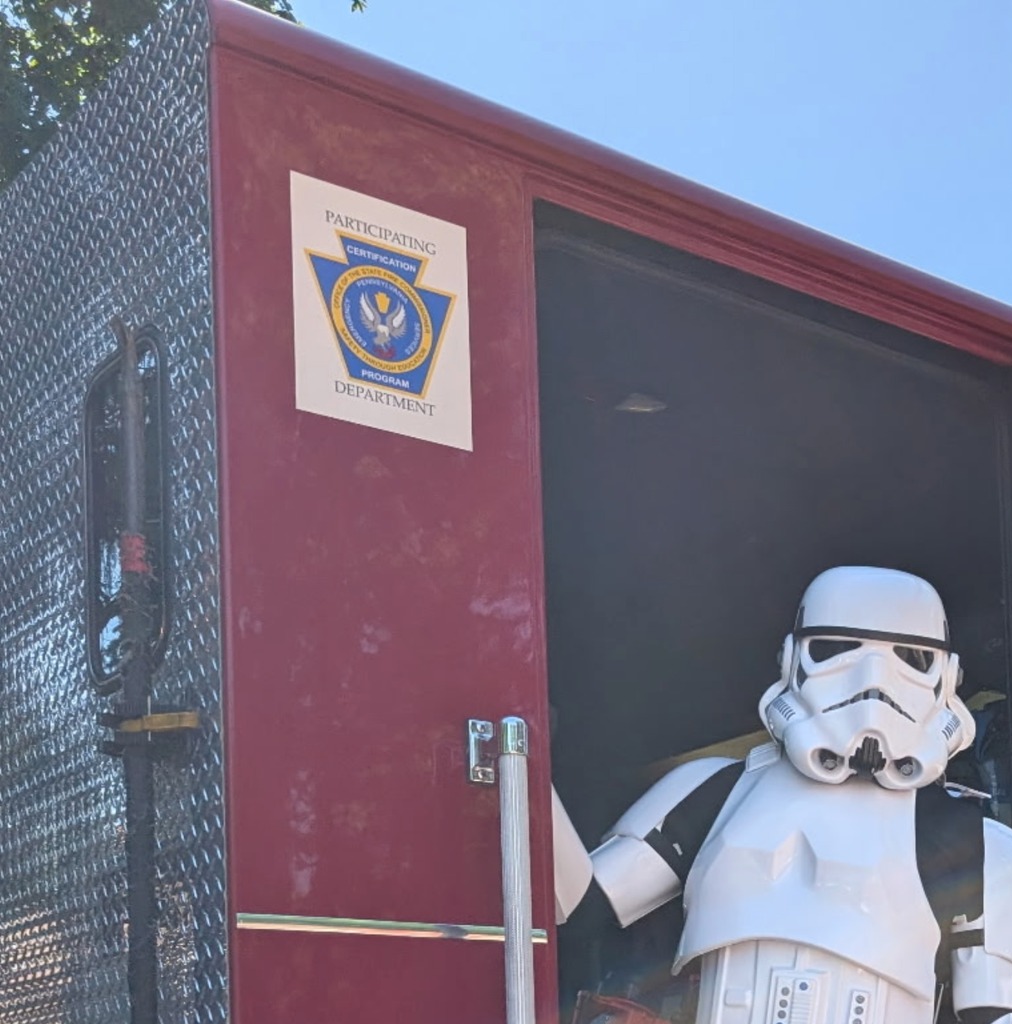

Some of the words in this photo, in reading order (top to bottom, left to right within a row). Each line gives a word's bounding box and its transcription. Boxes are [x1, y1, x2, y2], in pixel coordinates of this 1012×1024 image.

[325, 210, 437, 255] PARTICIPATING
[346, 245, 417, 274] CERTIFICATION
[348, 270, 361, 280] THE
[361, 267, 382, 276] STATE
[383, 271, 398, 283] FIRE
[399, 280, 431, 334] COMMISSIONER
[356, 278, 409, 305] PENNSYLVANIA
[361, 353, 397, 372] THROUGH
[397, 348, 428, 372] EDUCATION
[361, 369, 410, 390] PROGRAM
[334, 380, 436, 417] DEPARTMENT
